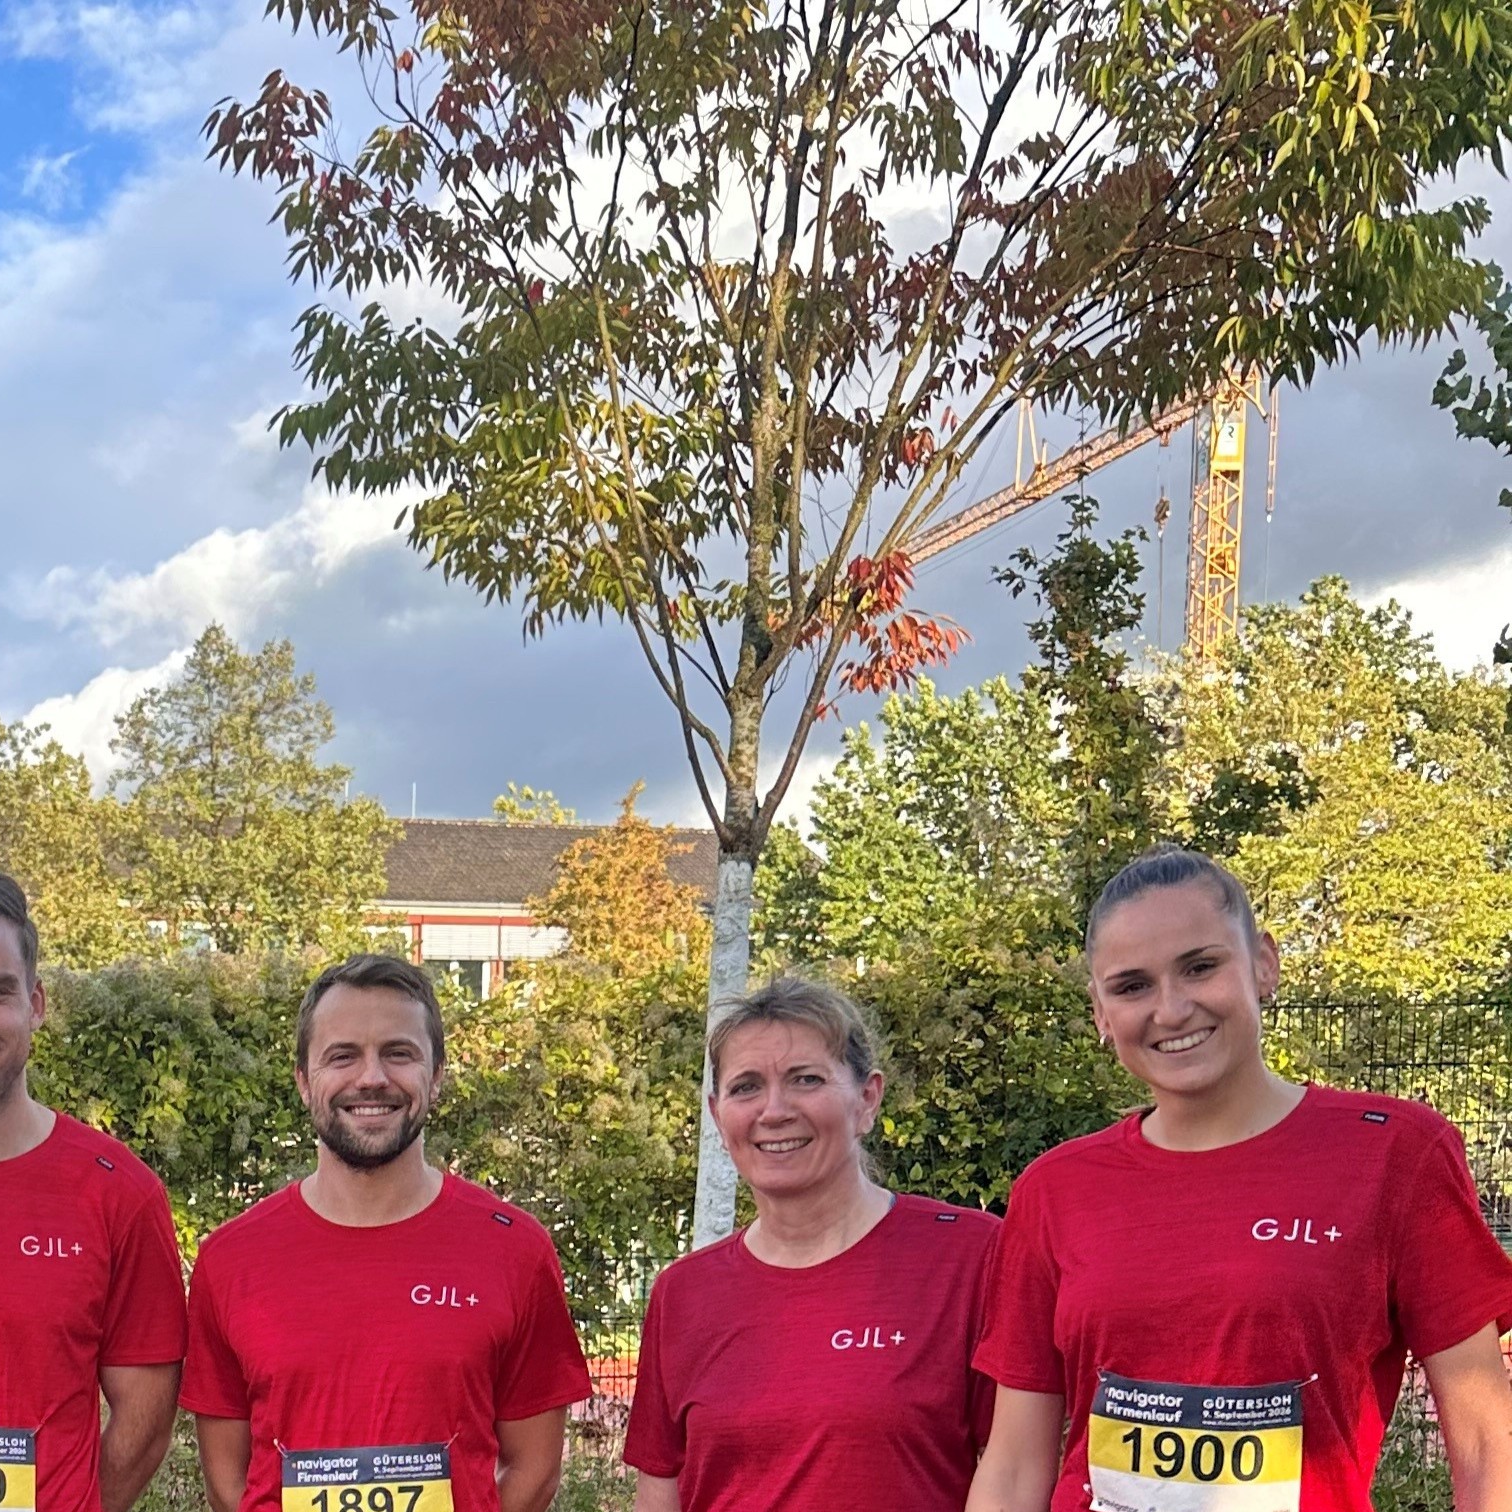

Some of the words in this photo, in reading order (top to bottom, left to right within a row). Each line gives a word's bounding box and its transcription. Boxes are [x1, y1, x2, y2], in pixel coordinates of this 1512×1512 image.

[1251, 1218, 1342, 1244] GJL+
[20, 1235, 83, 1258] GJL+
[410, 1284, 479, 1308] GJL+
[831, 1326, 906, 1350] GJL+
[1107, 1387, 1183, 1408] navigator
[1203, 1395, 1292, 1410] GÜTERSLOH
[1105, 1401, 1183, 1423] Firmenlauf
[1202, 1410, 1212, 1419] 9.
[1214, 1410, 1267, 1420] September
[1268, 1407, 1291, 1417] 2026
[297, 1456, 358, 1472] navigator
[373, 1453, 441, 1466] GÜTERSLOH
[1122, 1427, 1264, 1482] 1900
[297, 1469, 358, 1483] Firmenlauf
